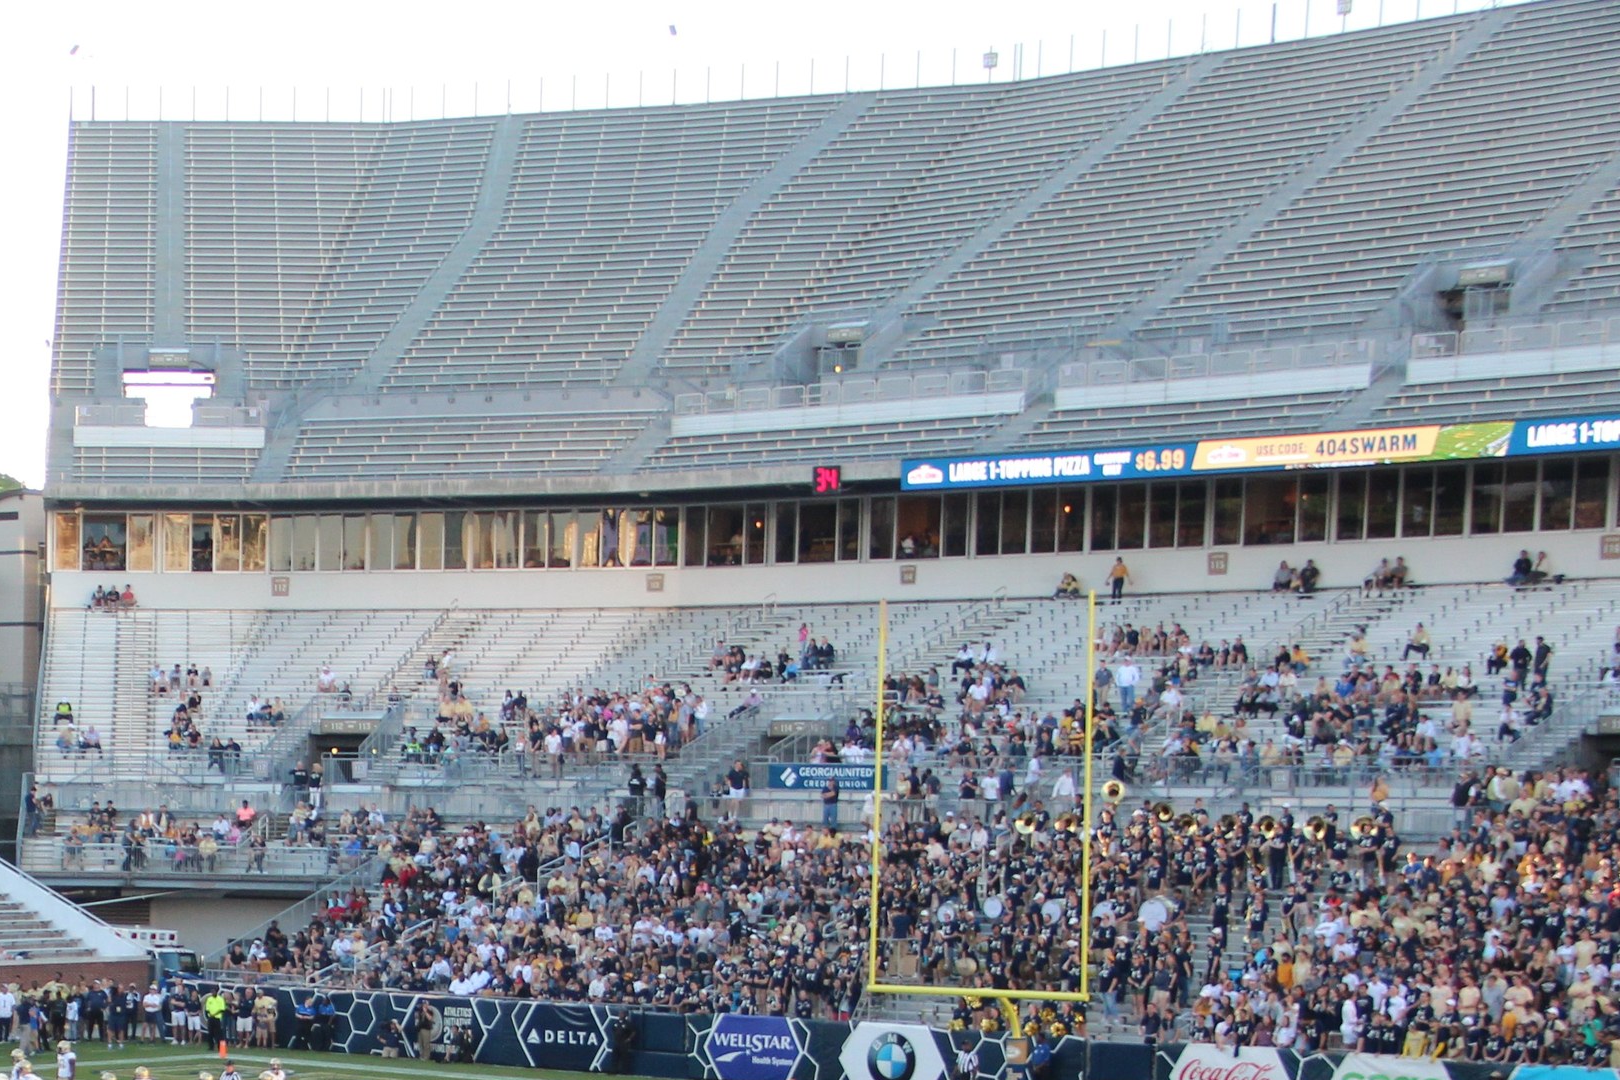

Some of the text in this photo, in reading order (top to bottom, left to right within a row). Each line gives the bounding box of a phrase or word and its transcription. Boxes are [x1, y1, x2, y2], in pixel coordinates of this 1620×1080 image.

[1256, 443, 1276, 456] USE
[1315, 433, 1417, 456] 404SWARM
[1527, 423, 1577, 447] LARGE
[949, 461, 988, 482] LARGE
[1054, 455, 1090, 476] PIZZA
[1135, 449, 1185, 471] $6.99
[816, 467, 840, 493] 34
[274, 584, 287, 592] 112
[803, 780, 868, 788] CREDI UNION
[545, 1030, 598, 1046] DELTA
[714, 1032, 790, 1052] WELLSTAR
[751, 1056, 770, 1065] Health
